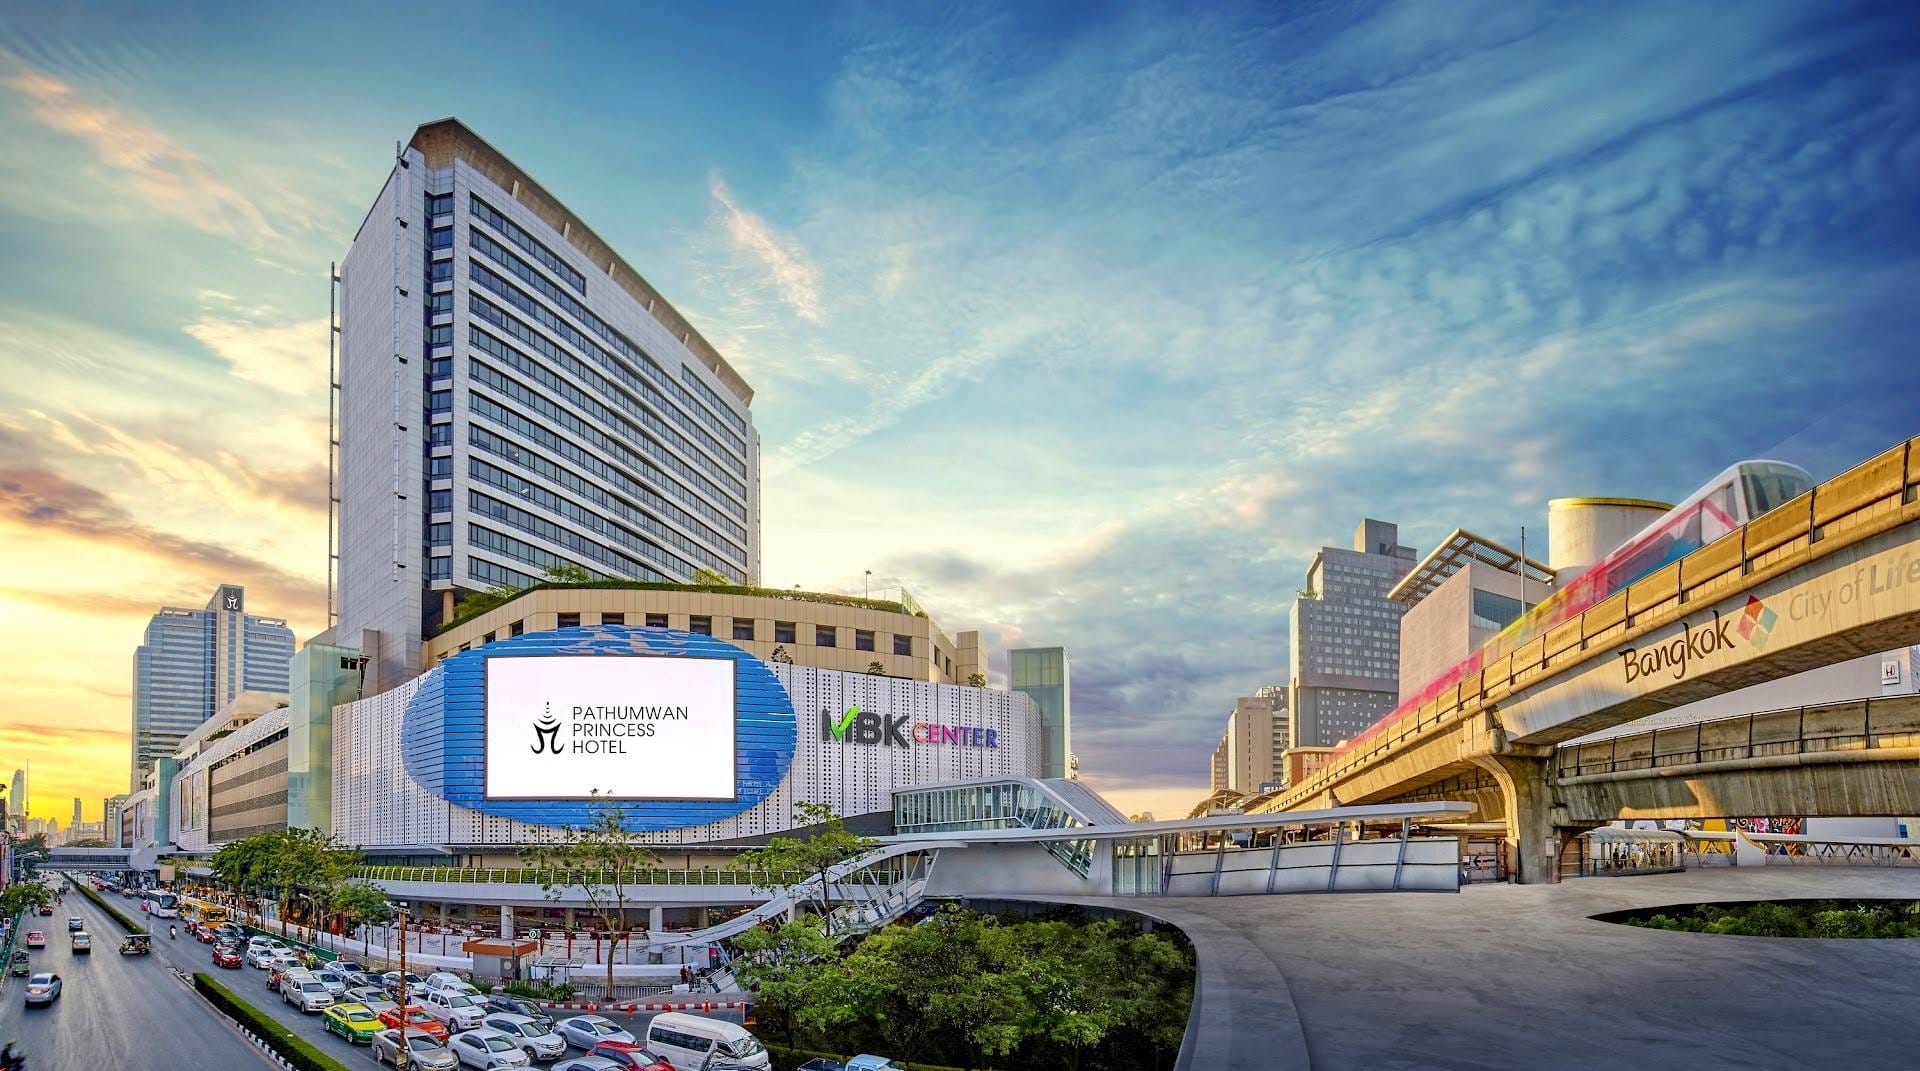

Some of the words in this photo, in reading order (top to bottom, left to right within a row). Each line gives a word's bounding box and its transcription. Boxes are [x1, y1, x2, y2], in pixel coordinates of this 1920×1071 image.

[1619, 610, 1735, 682] Bangkok
[1789, 591, 1832, 621] City
[1839, 568, 1864, 605] of
[573, 706, 688, 720] PATHUMWAN
[573, 723, 655, 737] PRINCESS
[822, 706, 910, 748] MBK
[913, 721, 998, 748] CENTER
[573, 740, 627, 754] HOTEL
